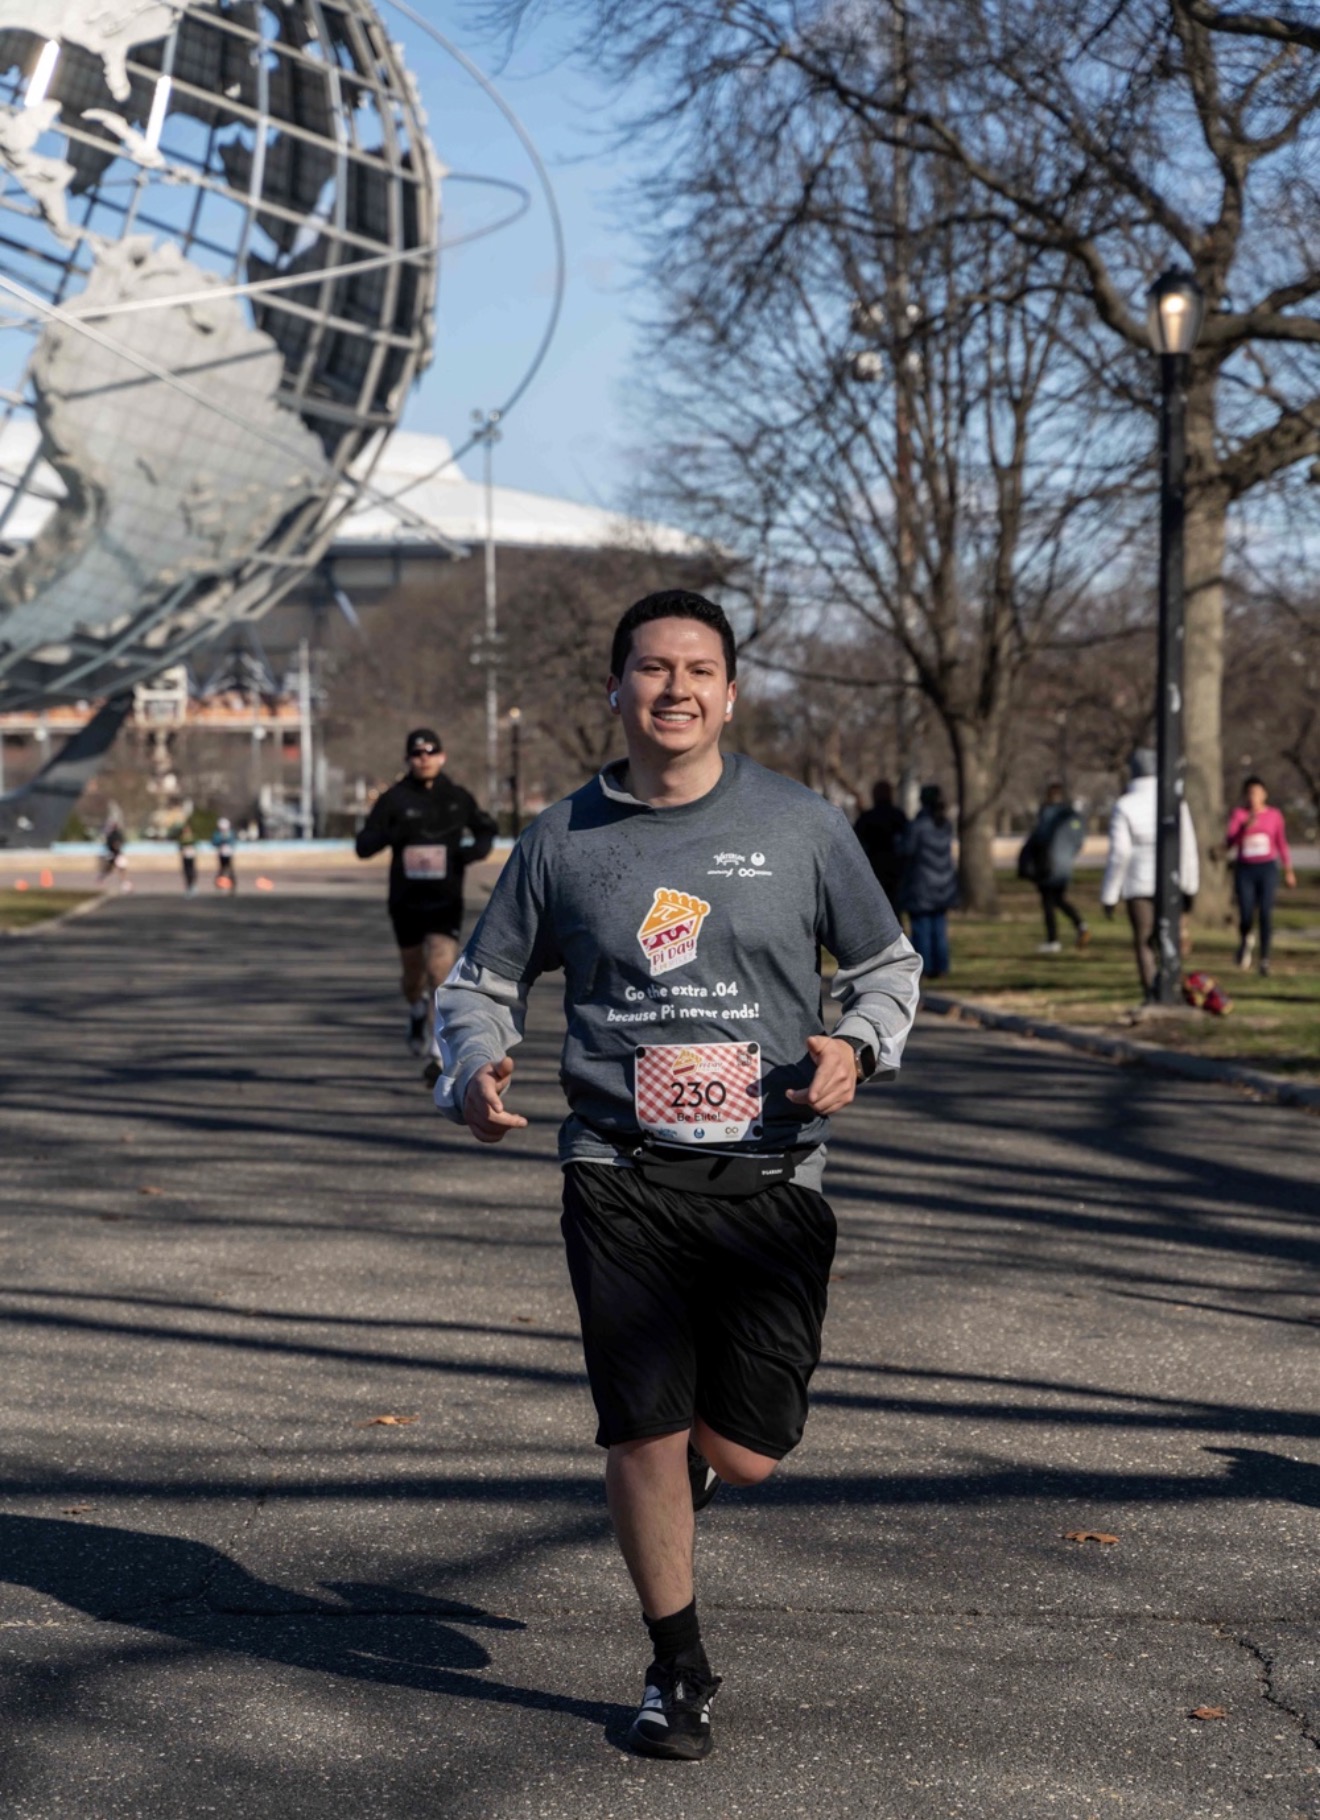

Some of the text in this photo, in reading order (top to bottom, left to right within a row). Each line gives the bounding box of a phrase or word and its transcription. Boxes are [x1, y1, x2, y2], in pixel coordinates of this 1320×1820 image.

[625, 981, 739, 1001] Go the extra .04
[606, 1002, 760, 1022] because Pi never ends!
[670, 1080, 727, 1108] 230
[677, 1112, 691, 1121] Be
